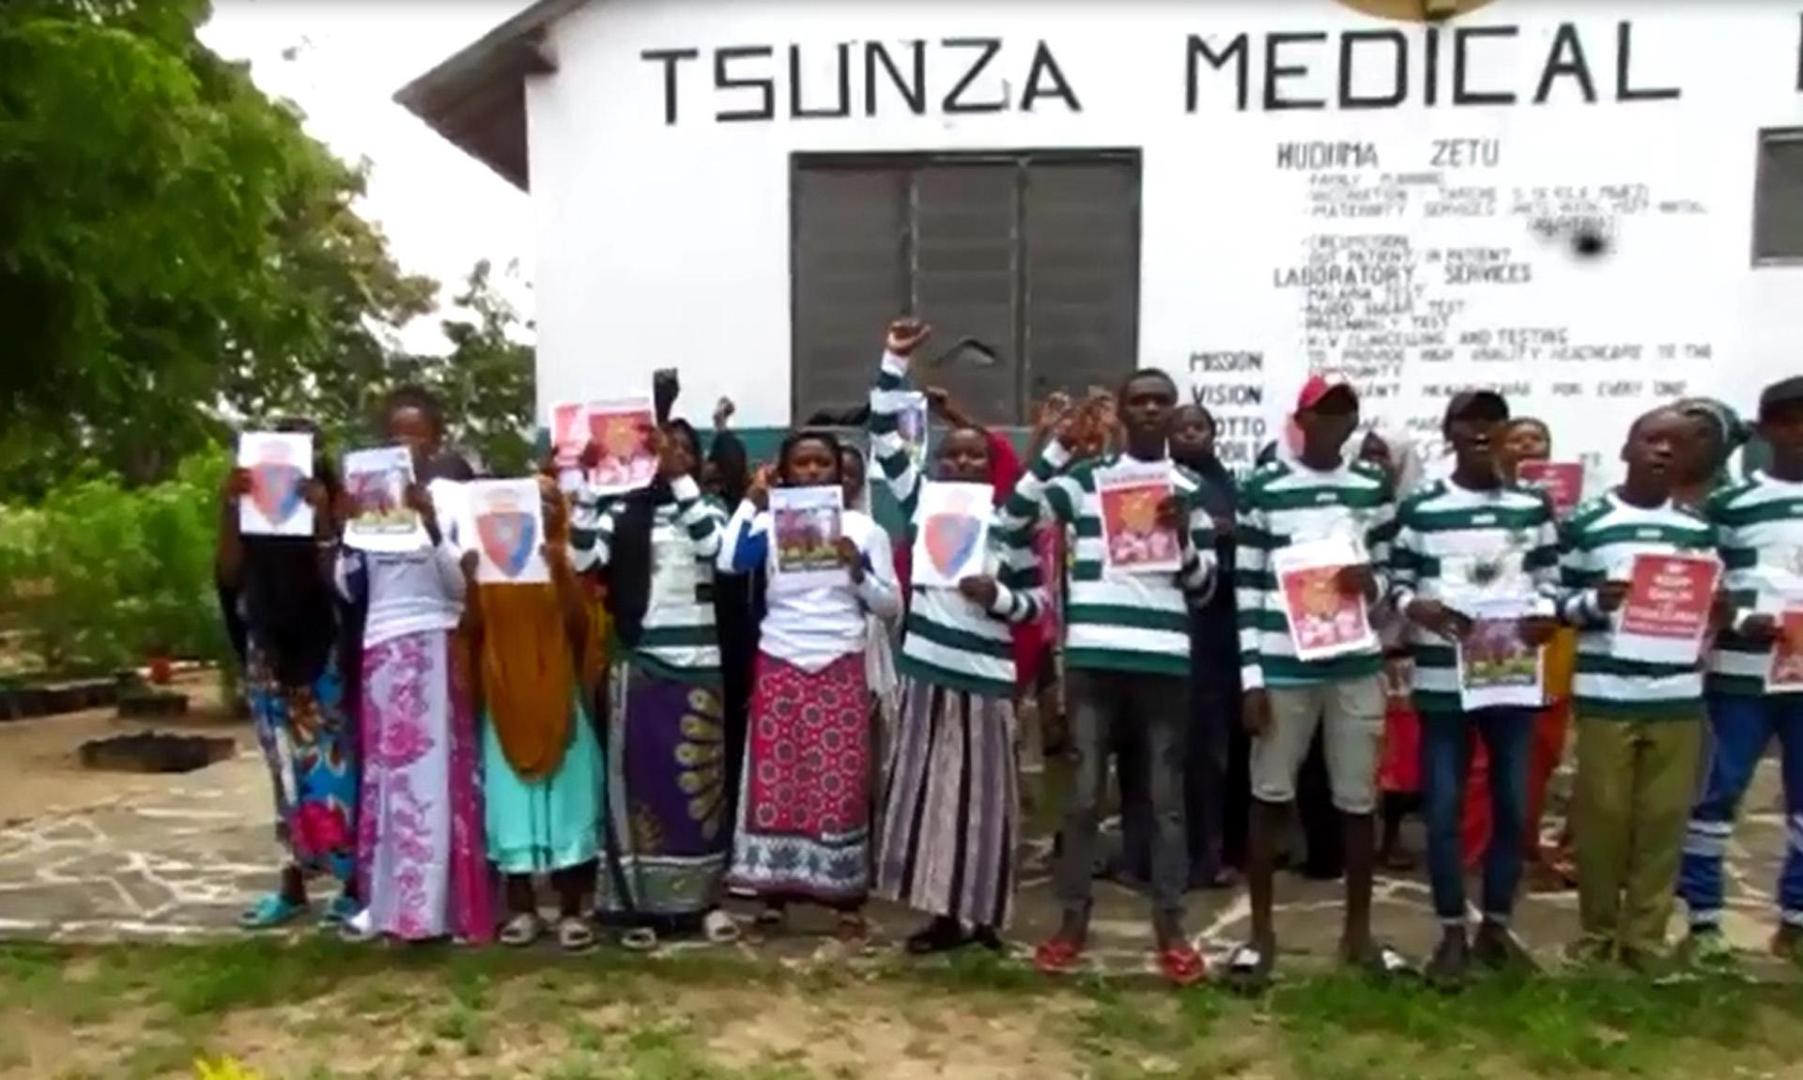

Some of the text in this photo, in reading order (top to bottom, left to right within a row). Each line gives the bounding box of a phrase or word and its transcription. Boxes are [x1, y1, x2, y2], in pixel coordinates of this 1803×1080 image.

[641, 21, 1681, 125] TSUNZA MEDICAL
[1429, 138, 1499, 168] ZETU
[1274, 262, 1532, 288] LABORATORY SERVICES
[1190, 351, 1263, 373] MISSION
[1192, 384, 1262, 407] VISION
[1214, 416, 1266, 438] OTTO
